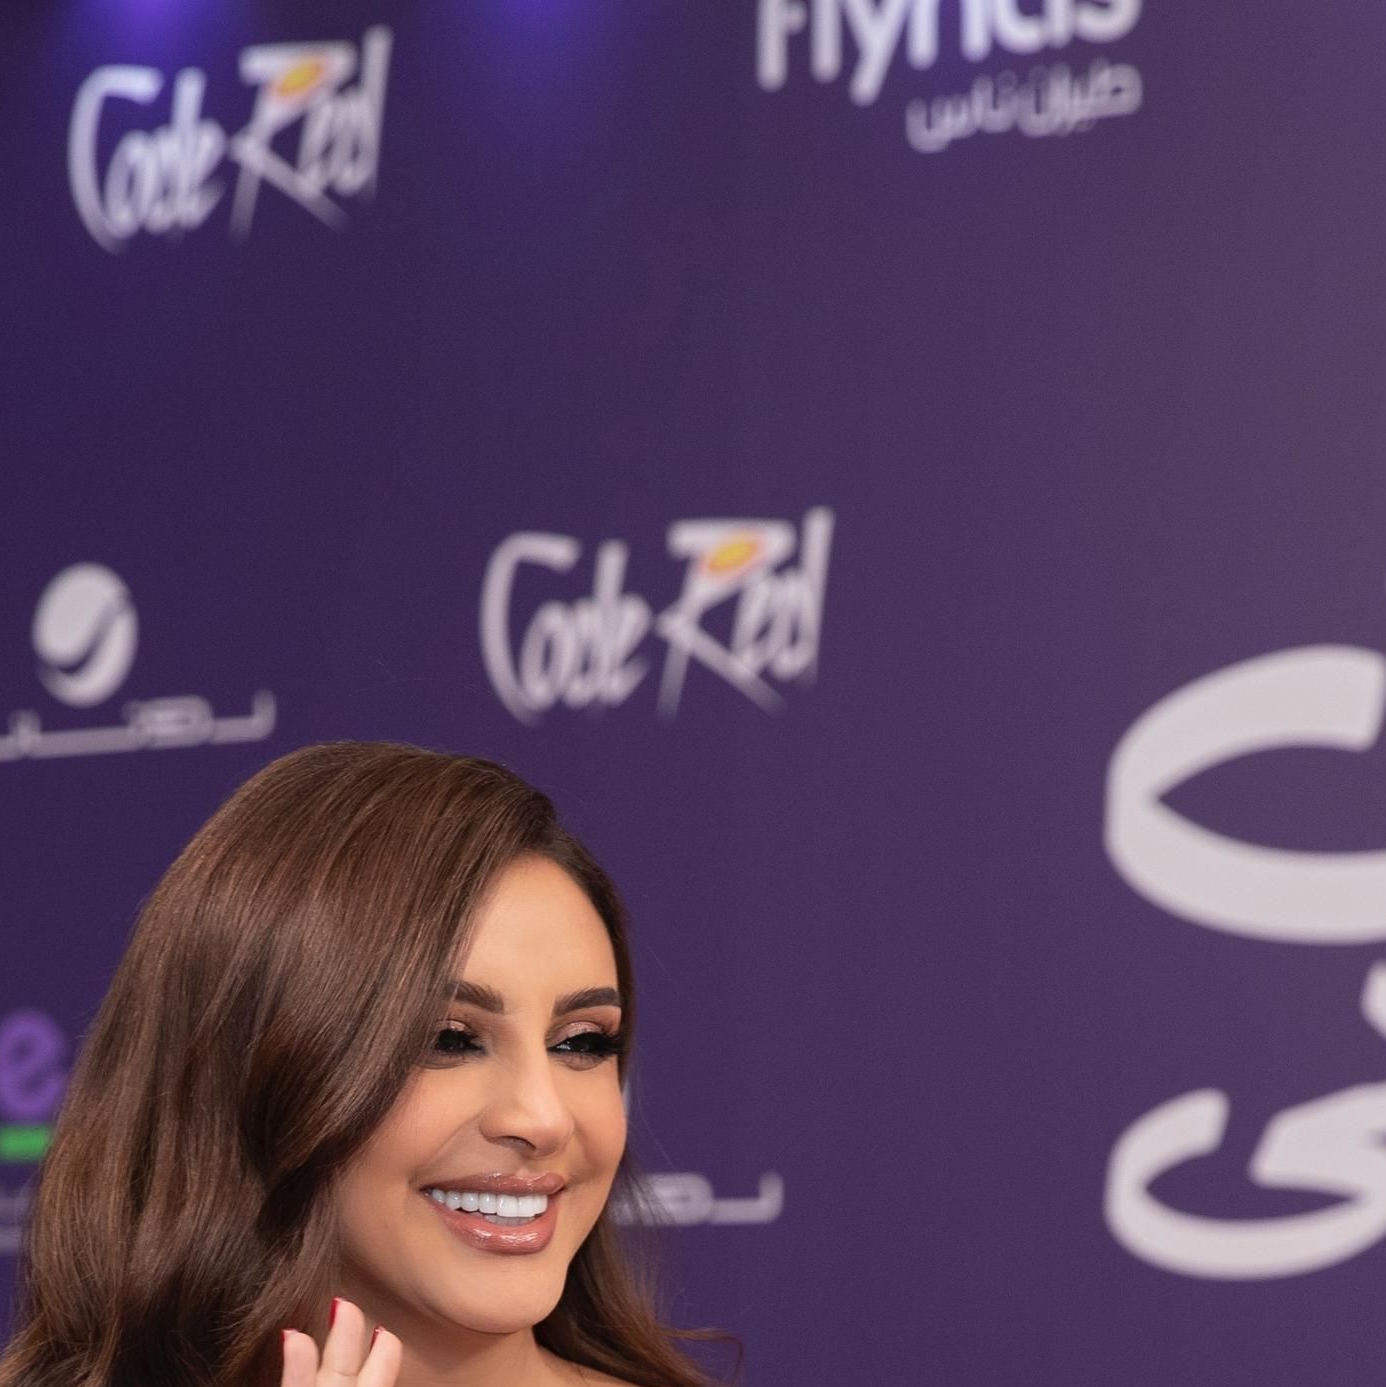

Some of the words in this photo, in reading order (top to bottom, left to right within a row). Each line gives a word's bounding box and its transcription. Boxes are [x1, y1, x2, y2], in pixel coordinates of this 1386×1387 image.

[67, 64, 227, 255] Code
[226, 24, 394, 247] Red
[479, 530, 654, 728] Code
[654, 505, 836, 723] Red
